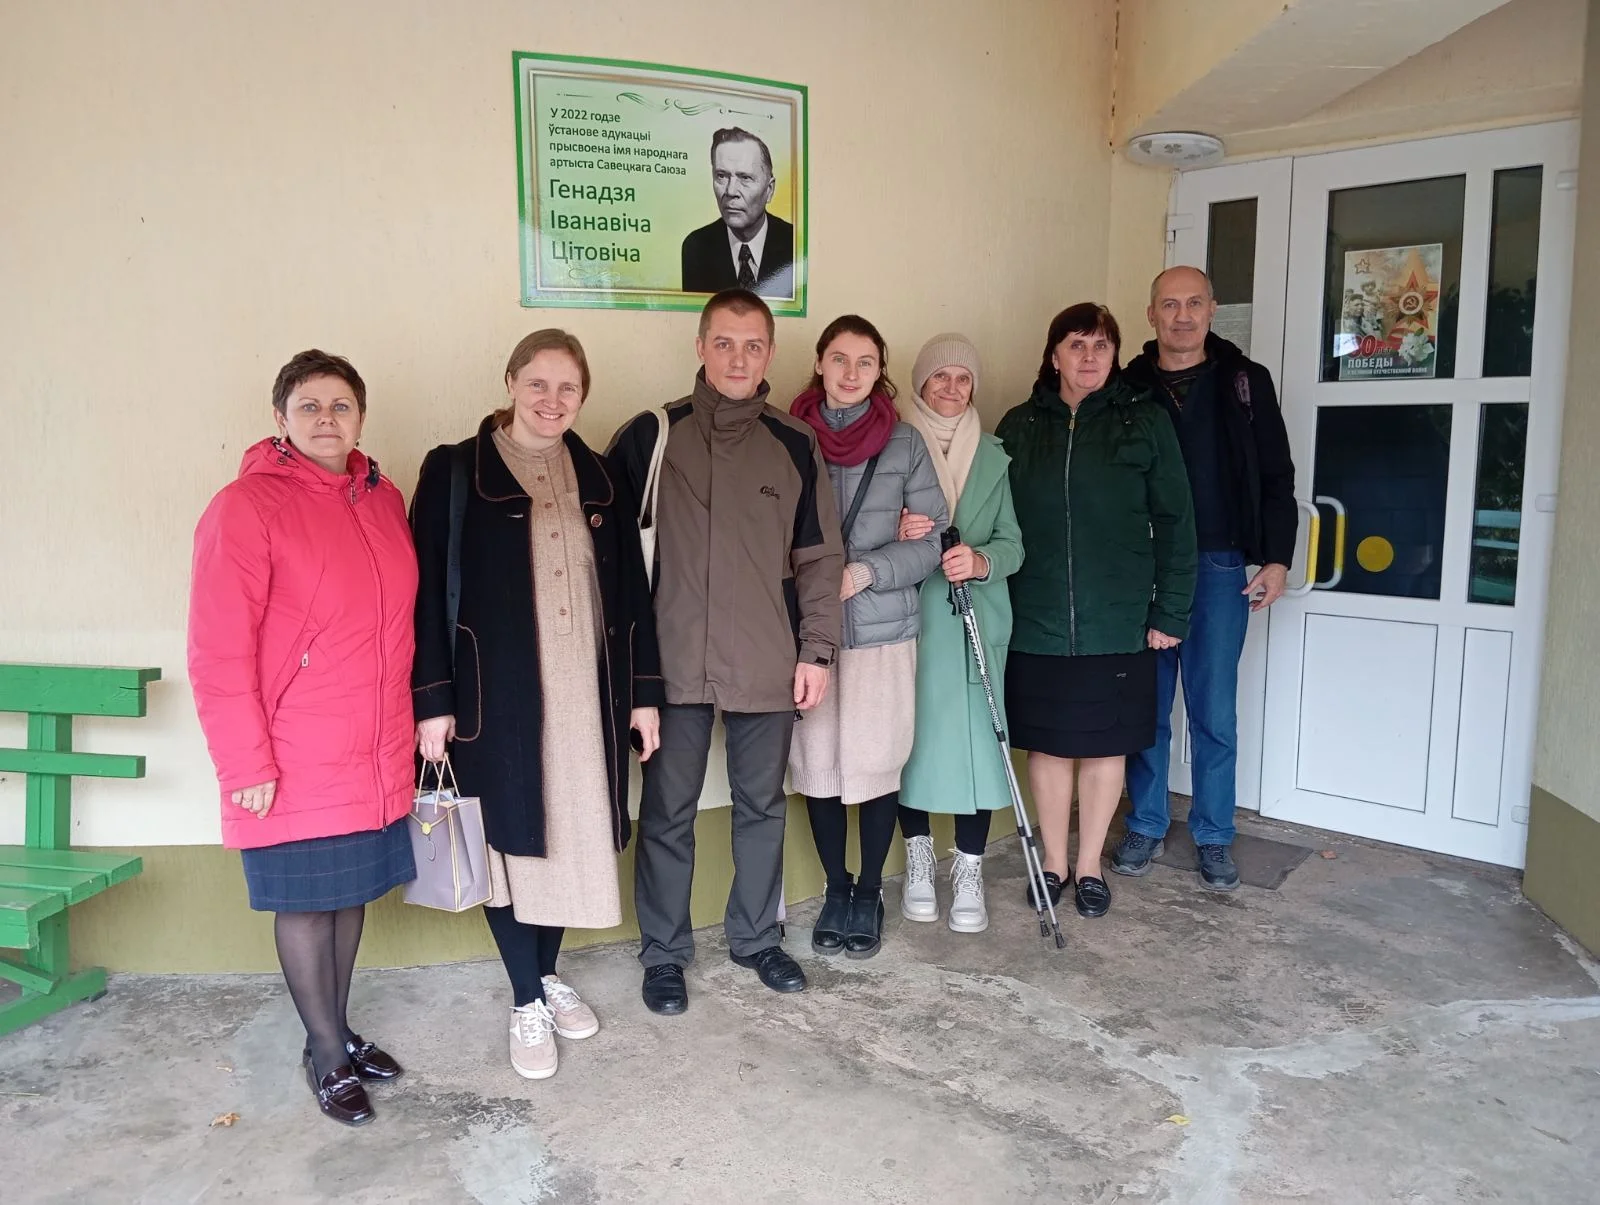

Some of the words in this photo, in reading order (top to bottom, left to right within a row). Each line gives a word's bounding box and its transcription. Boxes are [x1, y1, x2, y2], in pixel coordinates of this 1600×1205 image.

[550, 107, 558, 118] У
[561, 108, 588, 120] 2022
[590, 113, 621, 124] годзе
[549, 124, 599, 137] ўстанове
[601, 128, 651, 141] адукацыі
[550, 142, 611, 154] прысвоена
[613, 144, 631, 155] імя
[634, 147, 688, 160] народнага
[550, 158, 594, 169] артыста
[597, 159, 652, 173] Савецкага
[654, 163, 687, 175] Саюза
[550, 179, 635, 205] Генадзя
[551, 210, 651, 233] Іванавіча
[552, 240, 641, 264] Цітовіча
[1347, 357, 1393, 369] ПОБЕДЫ
